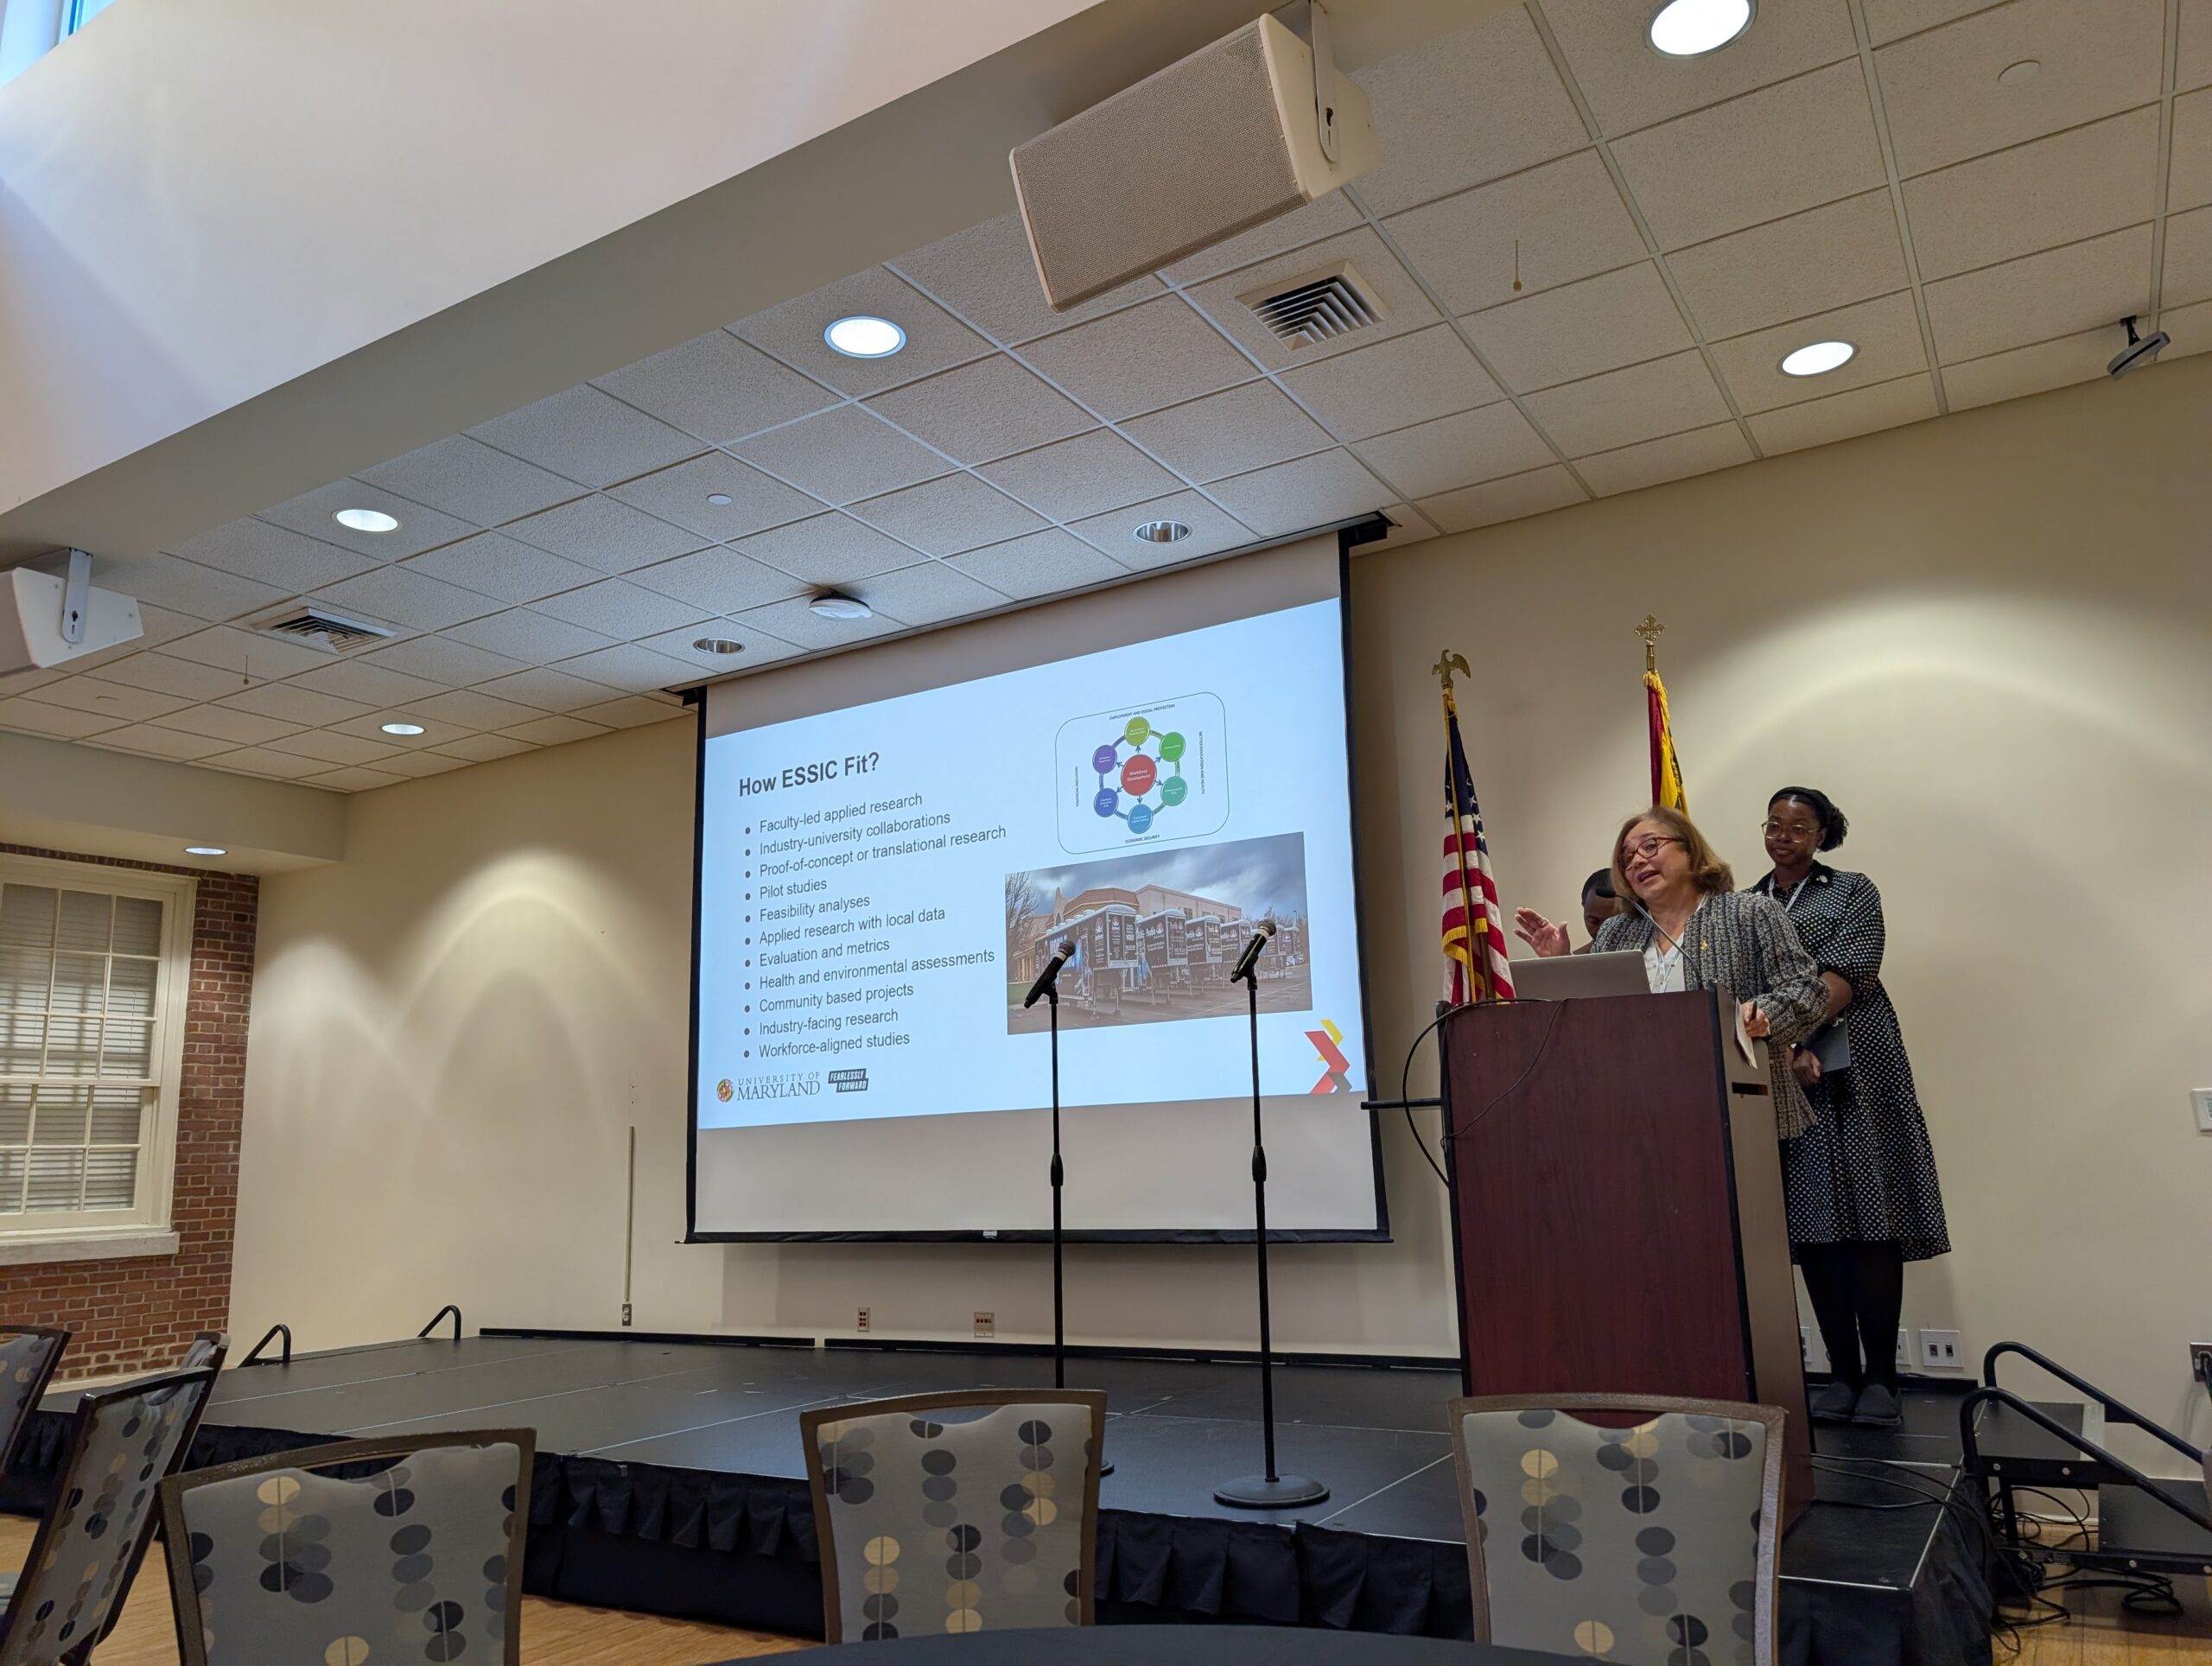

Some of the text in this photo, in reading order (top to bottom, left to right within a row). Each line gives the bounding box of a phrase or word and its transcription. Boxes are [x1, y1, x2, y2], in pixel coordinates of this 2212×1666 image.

[739, 752, 880, 797] How ESSIC Fit?
[760, 792, 923, 833] Faculty-led applied research
[760, 815, 951, 855] Industry-university collaborations
[760, 825, 1007, 877] Proof-of-concept or translational research
[760, 877, 828, 900] Pilot studies
[760, 895, 871, 922] Feasibility analyses
[759, 907, 946, 946] Applied research with local data
[760, 938, 891, 967] Evaluation and metrics
[760, 949, 995, 990] Health and environmental assessments
[759, 982, 915, 1013] Community based projects
[759, 1008, 899, 1036] Industry-facing research
[758, 1031, 911, 1059] Workforce-aligned studies
[737, 1071, 821, 1086] UNIVERSITY OF
[830, 1070, 865, 1082] FEARLESSLY
[837, 1080, 868, 1092] FORWARD
[736, 1080, 821, 1102] MARYLAND
